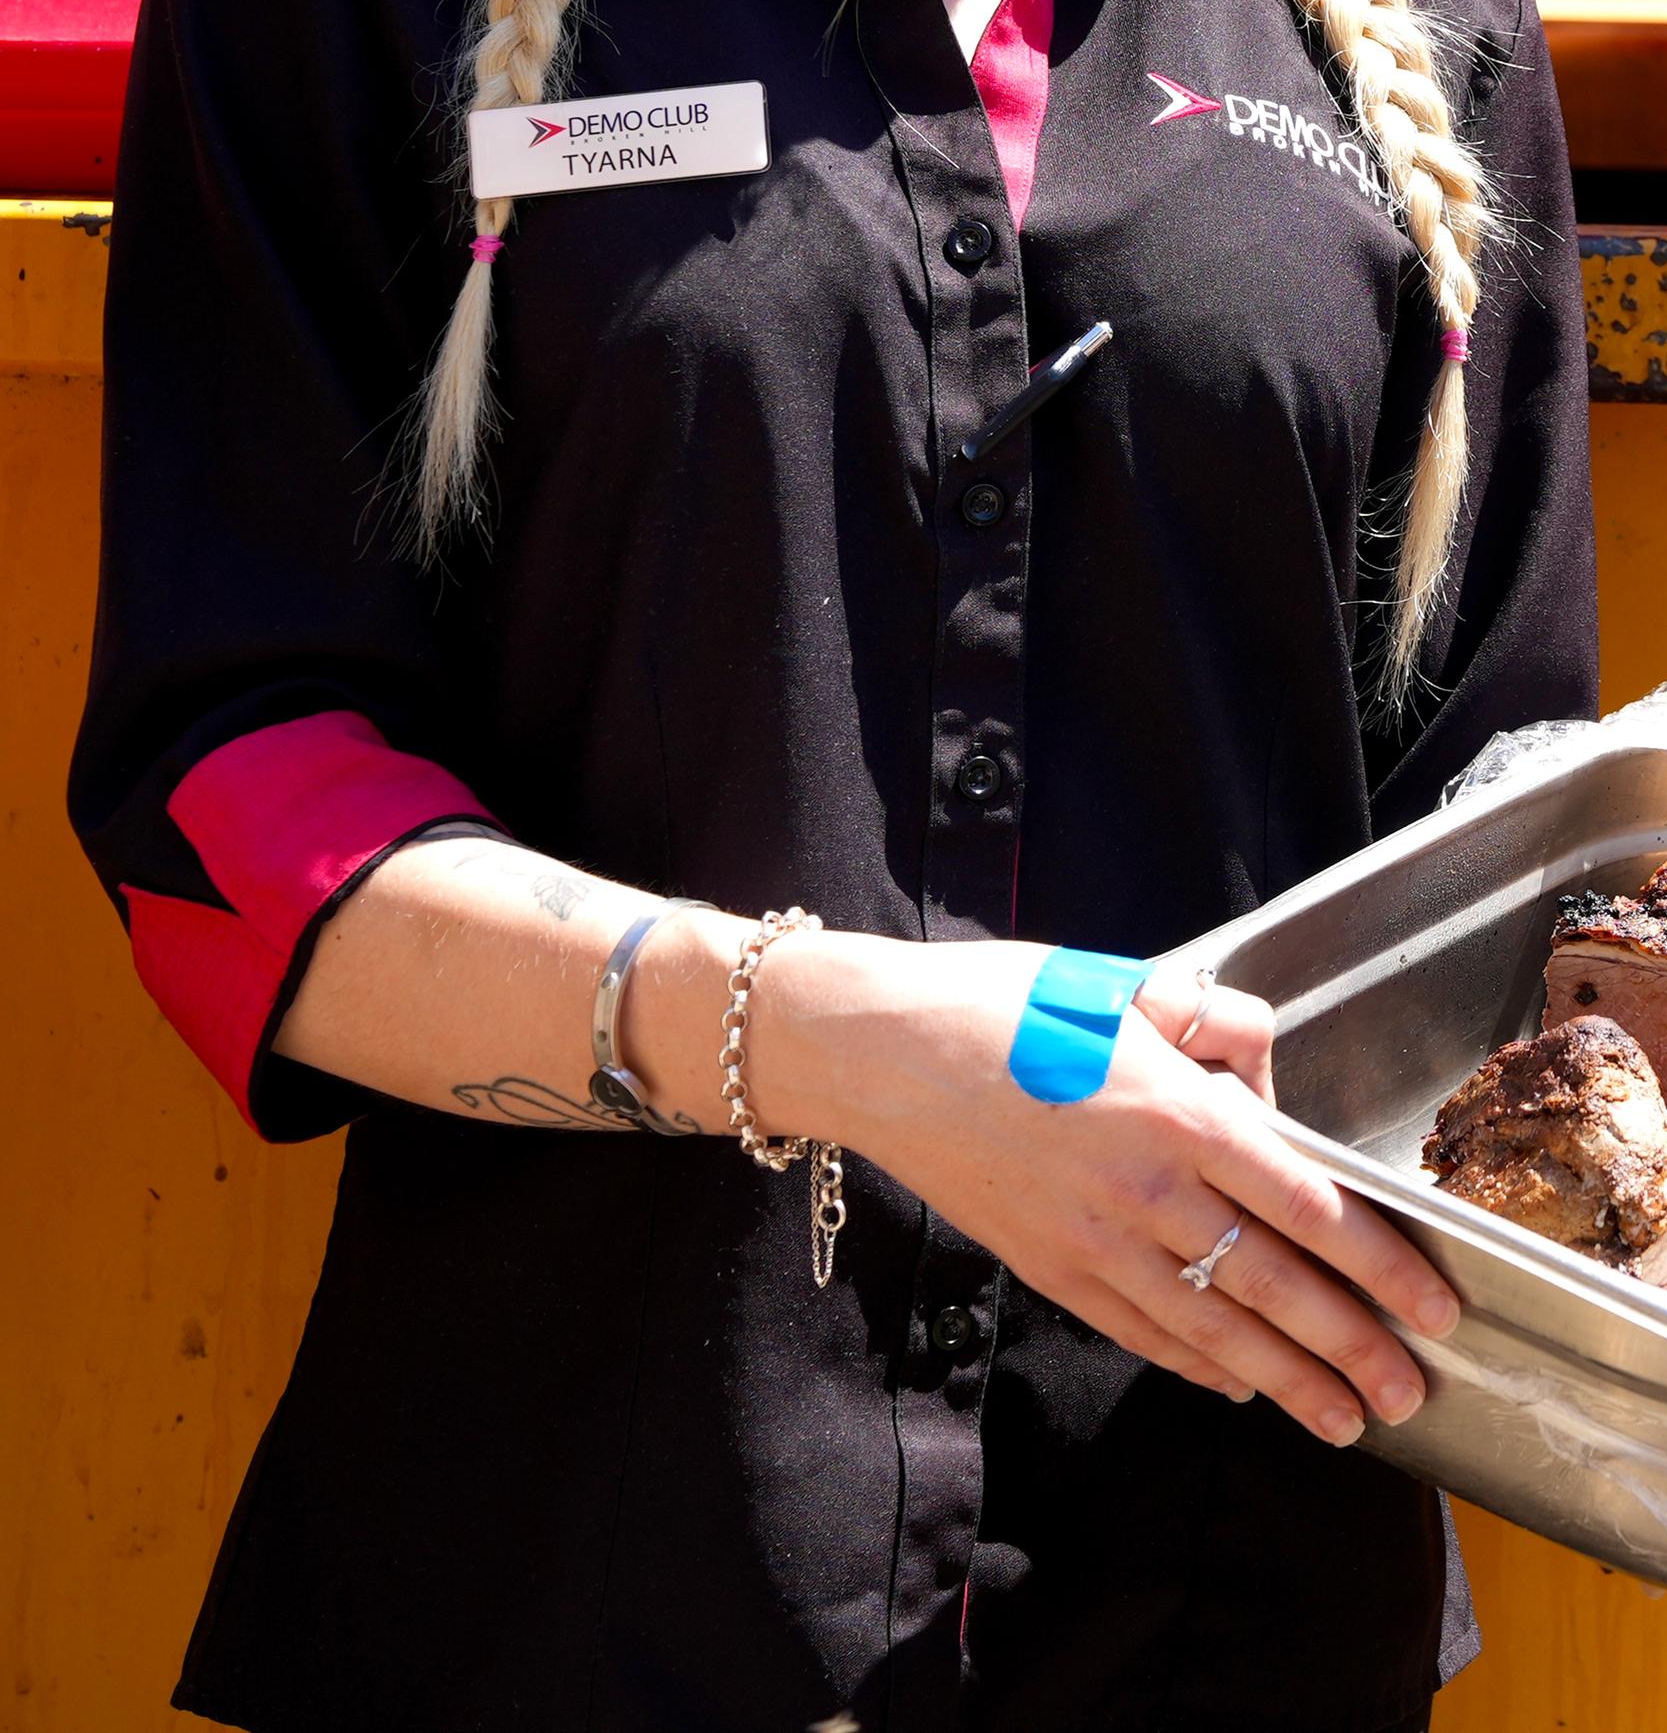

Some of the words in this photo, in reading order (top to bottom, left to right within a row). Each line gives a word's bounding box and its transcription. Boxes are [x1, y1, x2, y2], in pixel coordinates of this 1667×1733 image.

[568, 110, 643, 138] DEMO
[647, 103, 709, 128] CLUB
[1224, 94, 1334, 158] DEMO
[562, 144, 678, 176] TYARNA
